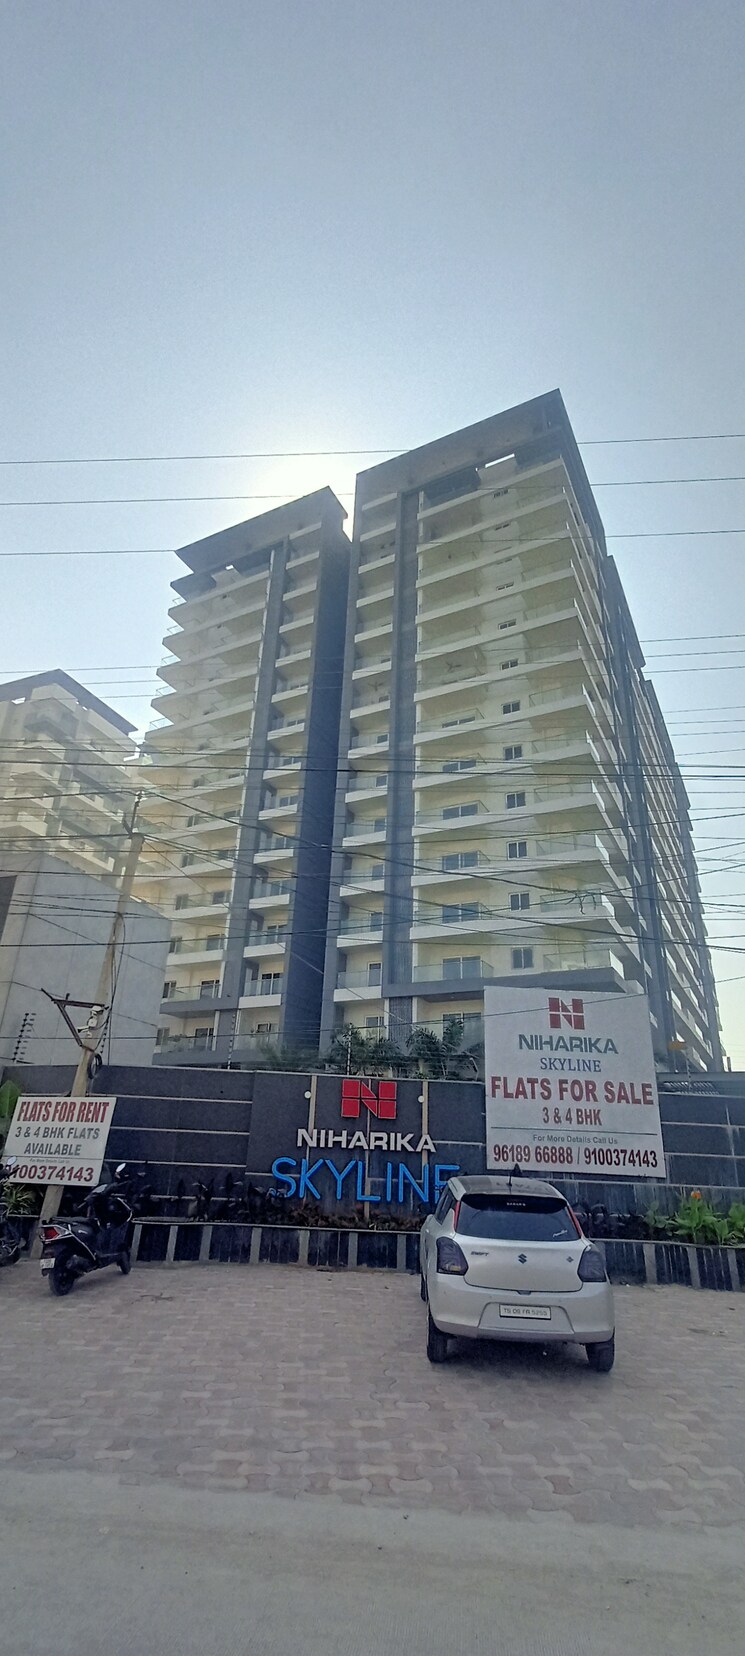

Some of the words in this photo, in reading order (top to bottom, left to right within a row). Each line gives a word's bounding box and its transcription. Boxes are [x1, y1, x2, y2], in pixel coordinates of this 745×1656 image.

[518, 1034, 619, 1054] NIHARIKA
[540, 1057, 602, 1073] SKYLINE
[491, 1076, 552, 1100] FLATS
[558, 1079, 599, 1102] FOR
[604, 1081, 654, 1105] SALE
[17, 1101, 53, 1122] FLATS
[51, 1101, 77, 1122] FOR
[76, 1101, 110, 1123] RENT
[542, 1107, 550, 1124] 3
[553, 1108, 562, 1124] &
[565, 1109, 573, 1125] 4
[576, 1109, 602, 1126] BHK
[15, 1126, 22, 1138] 3
[24, 1127, 31, 1137] &
[34, 1127, 41, 1138] 4
[42, 1127, 66, 1139] BHK
[67, 1128, 100, 1139] FLATS
[297, 1128, 436, 1153] NIHARIKA
[533, 1134, 546, 1142] For
[548, 1135, 565, 1143] More
[566, 1136, 591, 1144] Details
[592, 1137, 607, 1145] Call
[24, 1143, 82, 1156] AVAILABLE
[493, 1144, 531, 1163] 96189
[534, 1146, 573, 1165] 66888
[584, 1148, 658, 1168] 9100374143
[6, 1165, 94, 1182] 100374143
